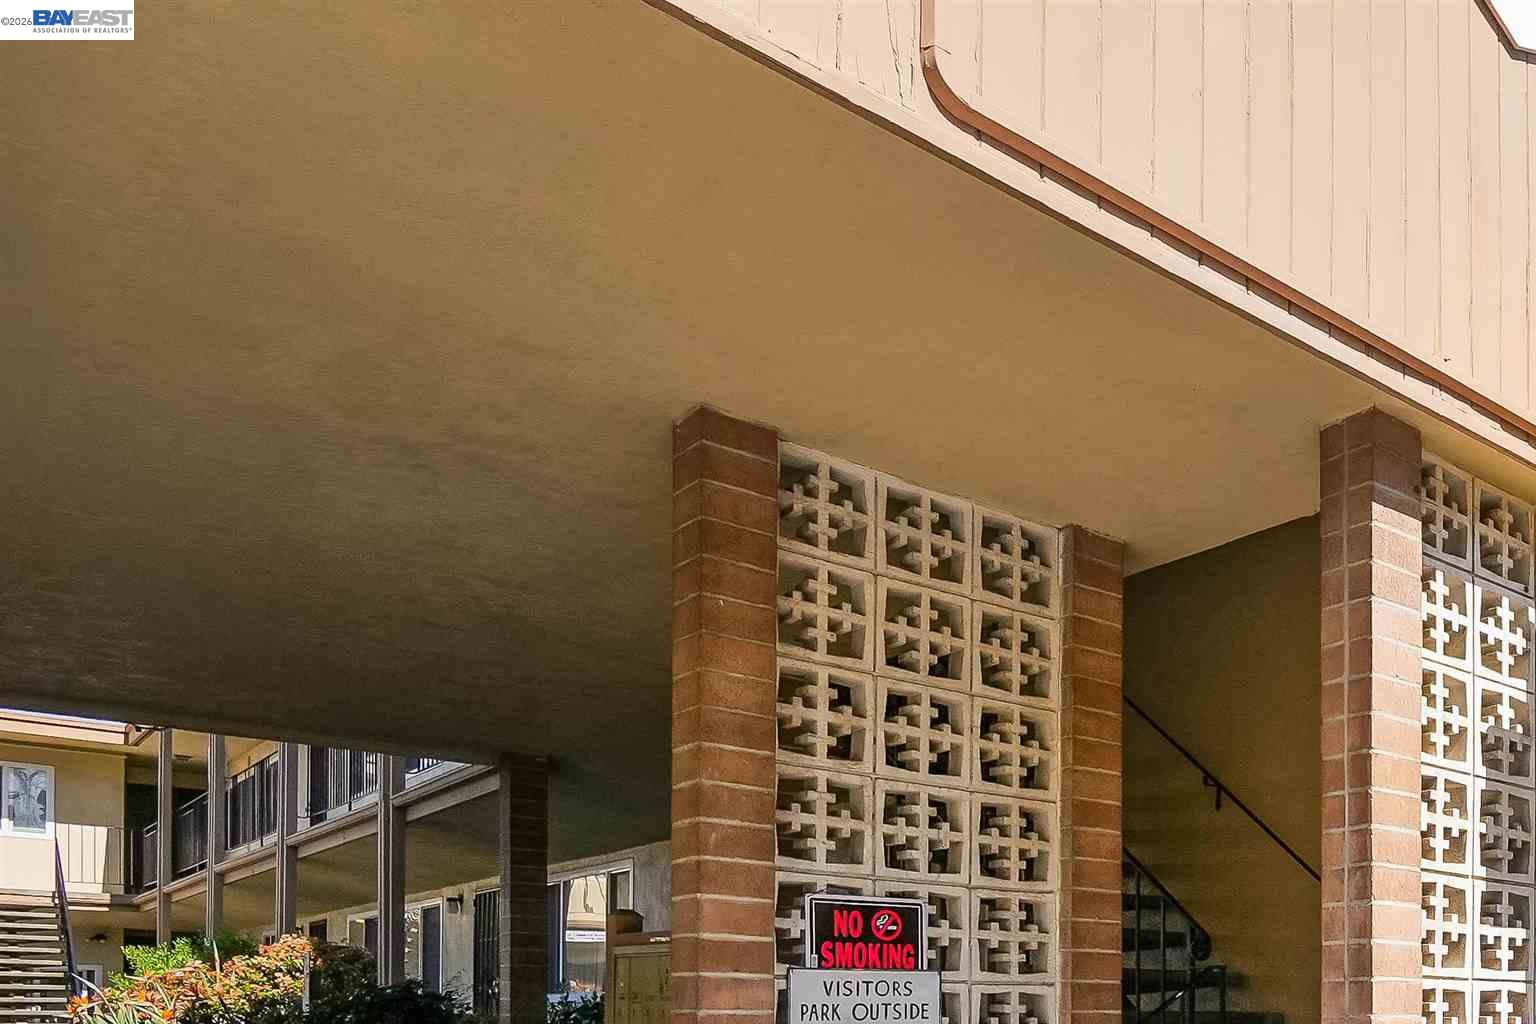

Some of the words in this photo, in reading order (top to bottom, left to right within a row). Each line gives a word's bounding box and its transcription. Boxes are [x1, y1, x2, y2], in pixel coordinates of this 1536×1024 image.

[833, 909, 864, 938] NO
[820, 941, 916, 970] SMOKING
[823, 979, 913, 997] VISITORS
[800, 1003, 841, 1021] PARK
[852, 1002, 929, 1021] OUTSIDE
